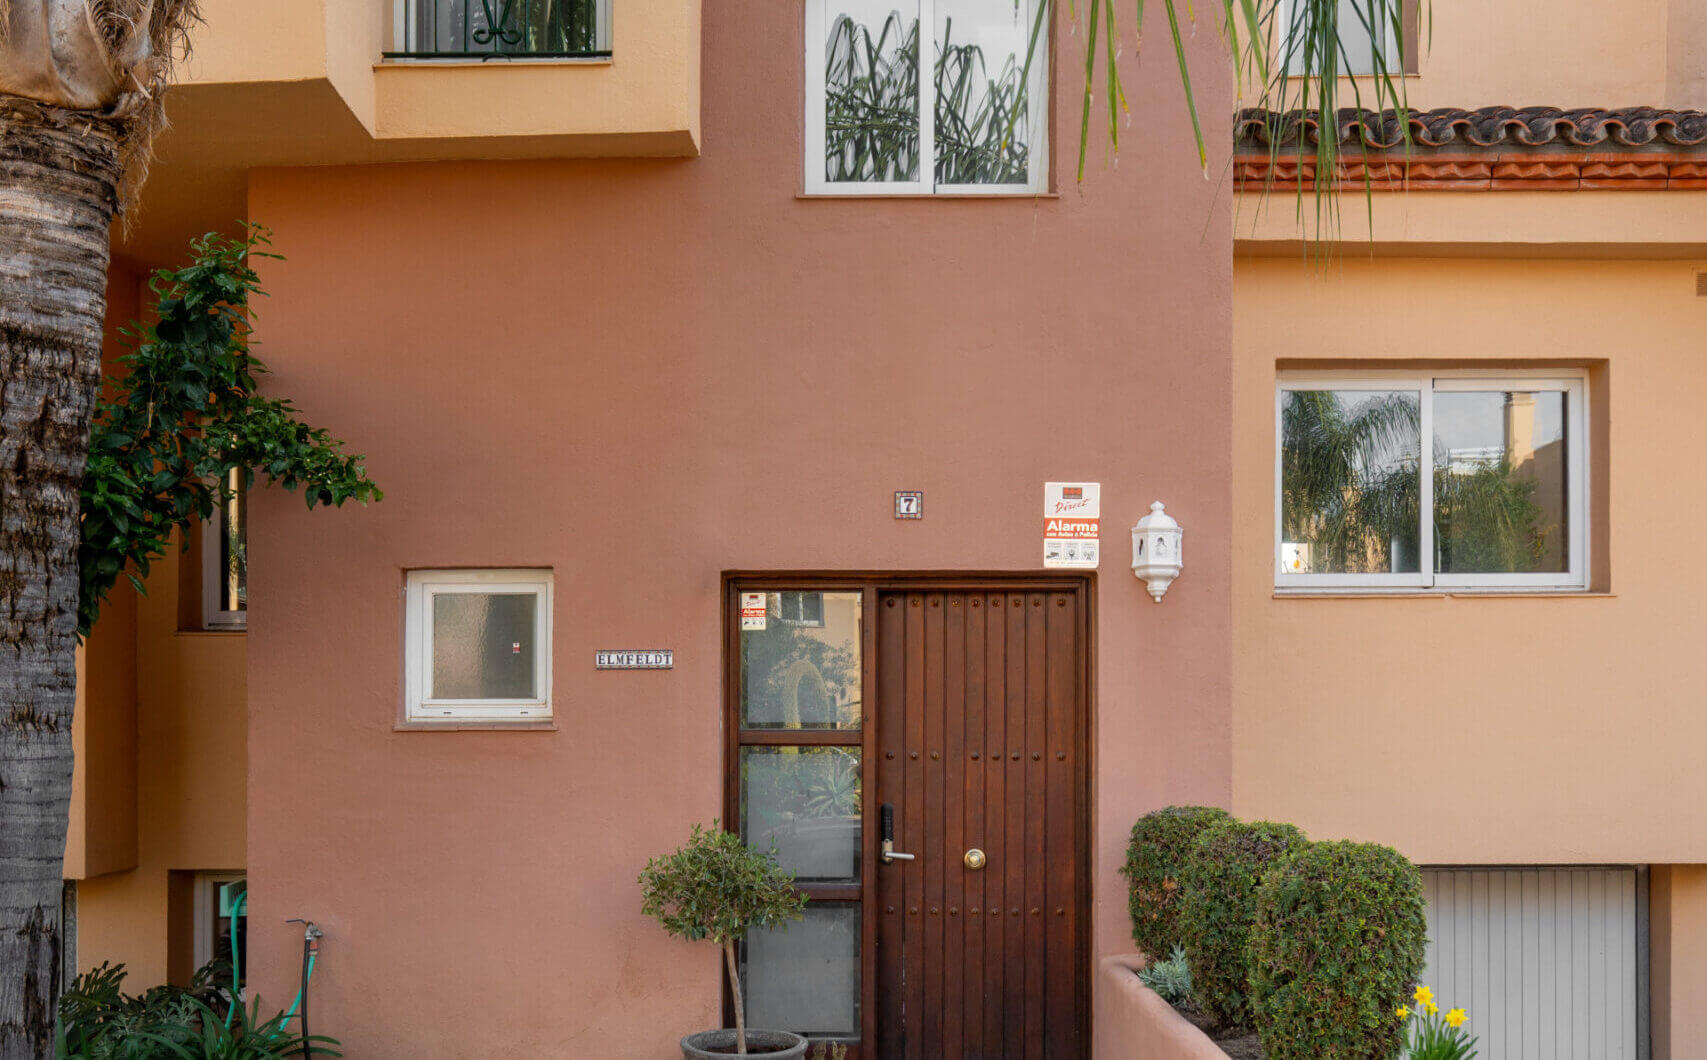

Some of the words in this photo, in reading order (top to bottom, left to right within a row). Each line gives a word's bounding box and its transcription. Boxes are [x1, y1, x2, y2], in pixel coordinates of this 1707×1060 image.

[904, 498, 914, 512] 7
[1047, 520, 1098, 531] Alarma
[598, 654, 672, 665] ELMFELDT
